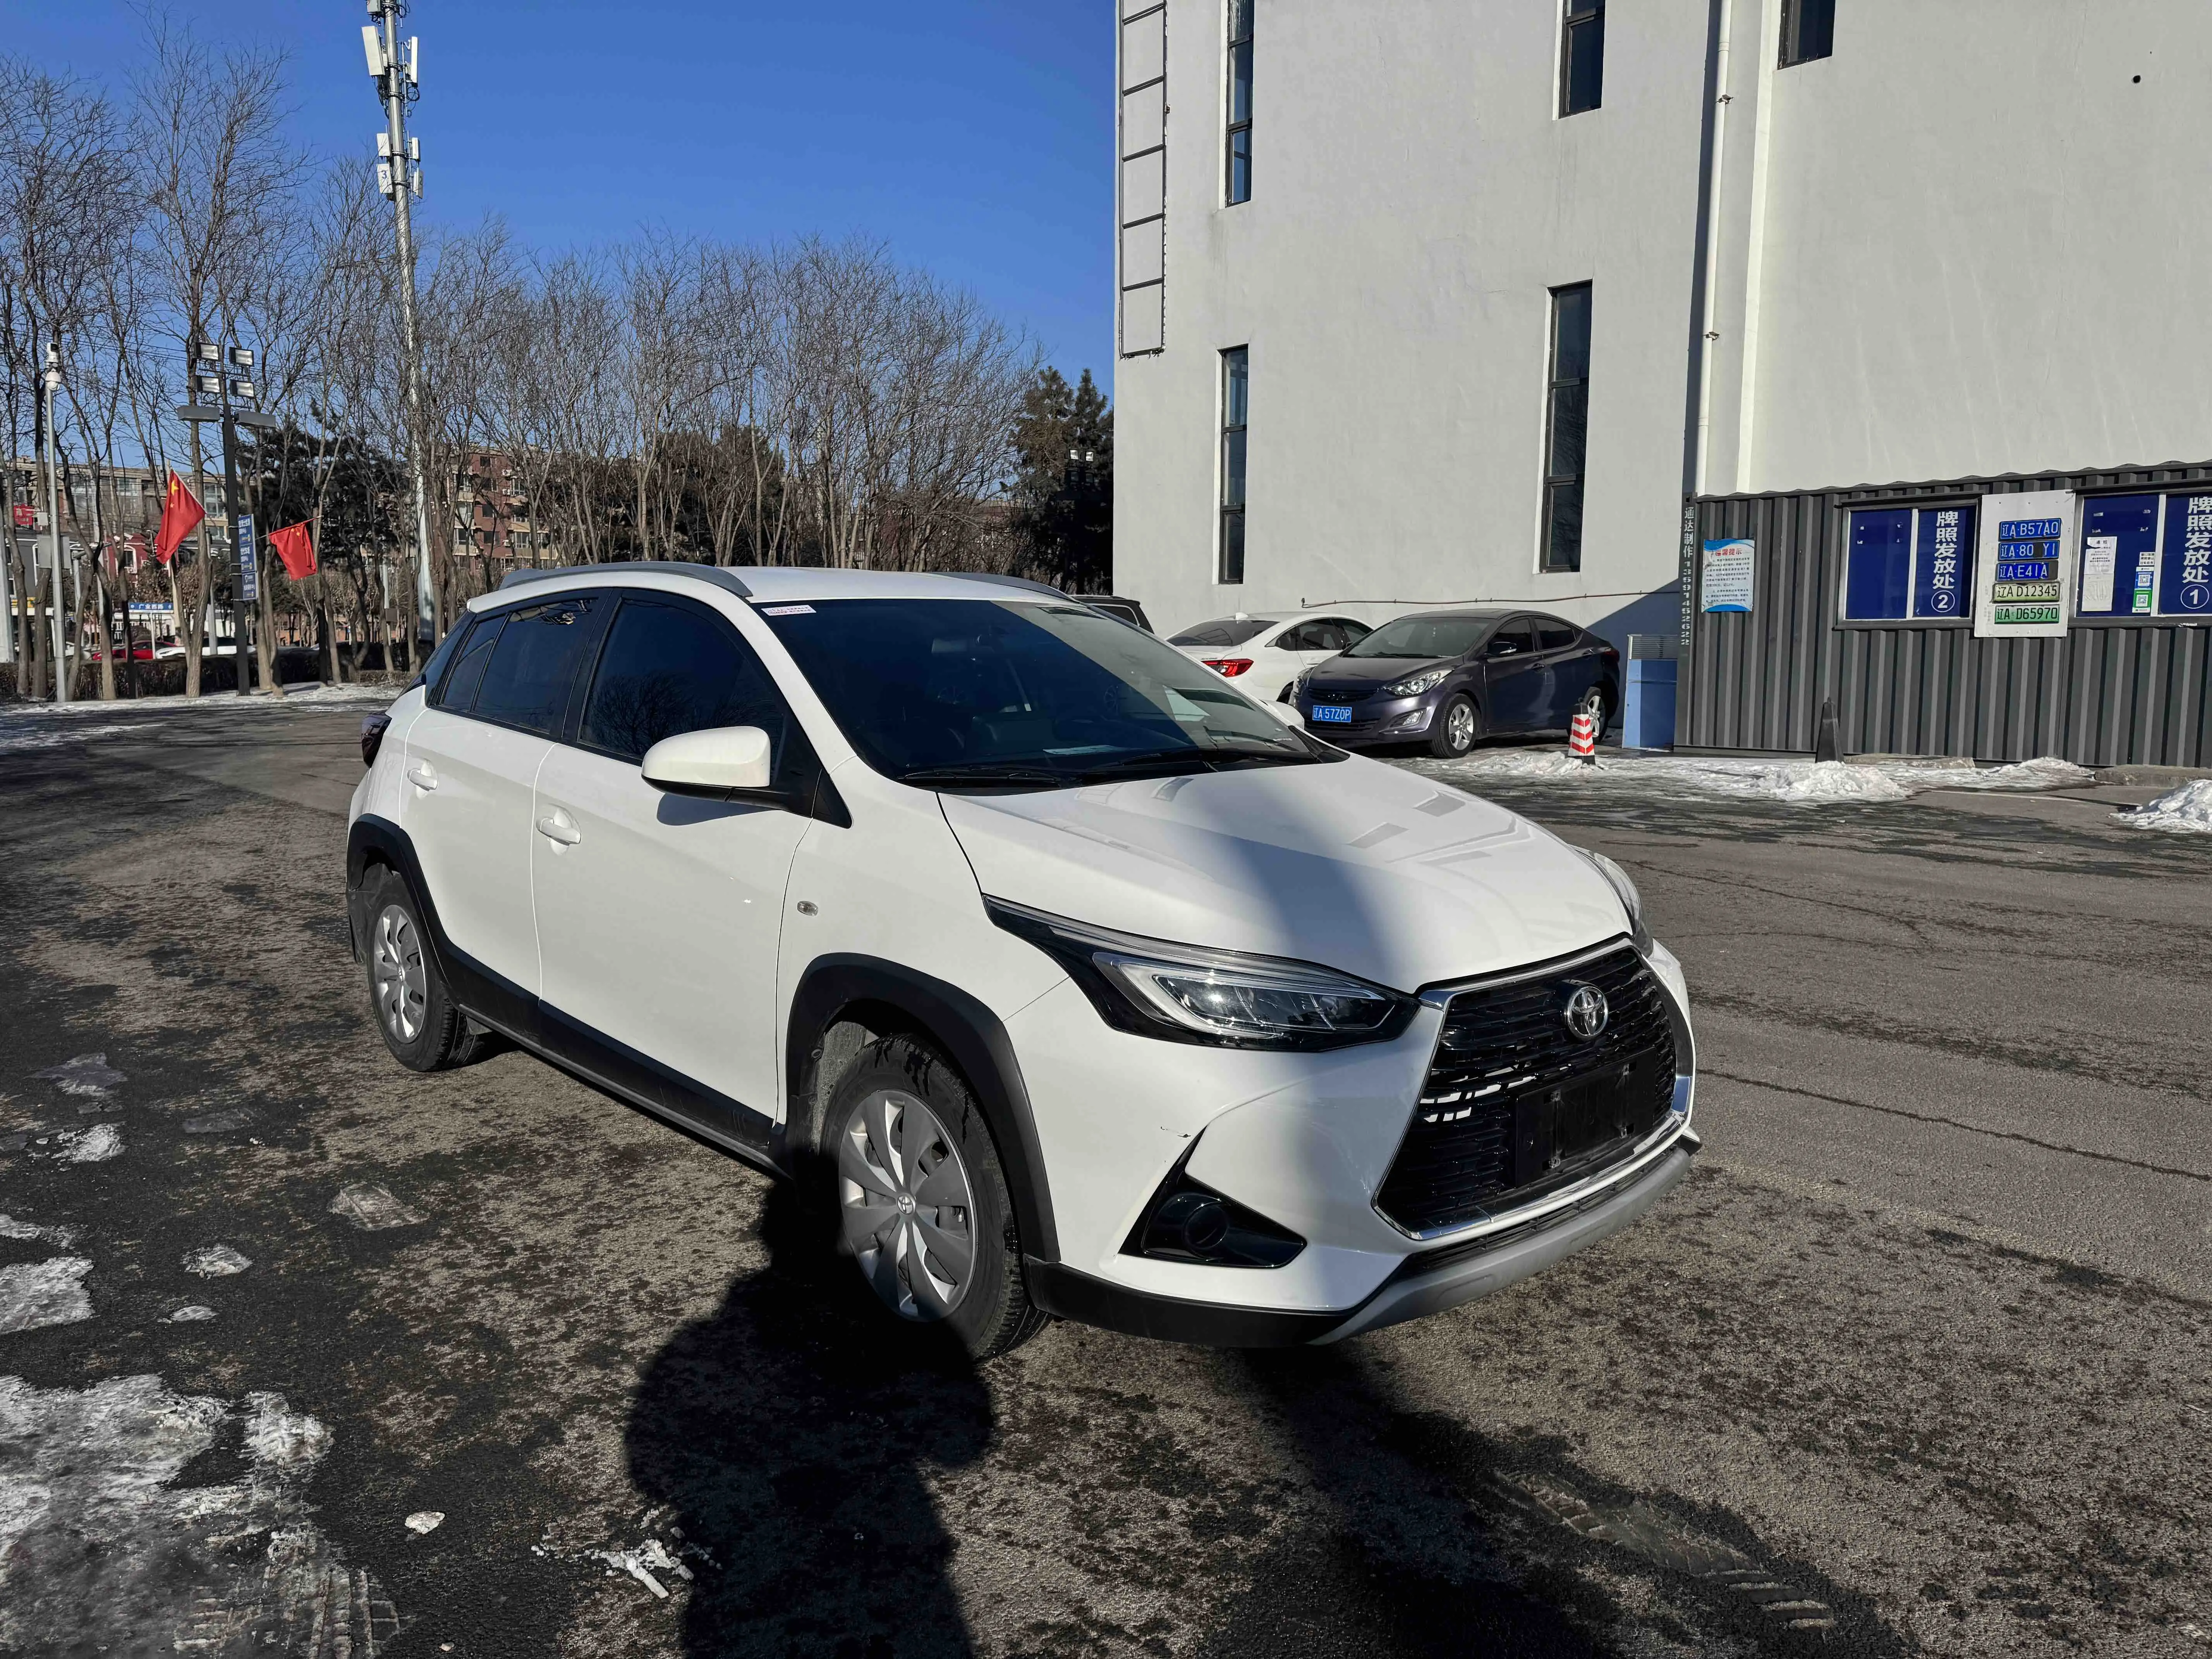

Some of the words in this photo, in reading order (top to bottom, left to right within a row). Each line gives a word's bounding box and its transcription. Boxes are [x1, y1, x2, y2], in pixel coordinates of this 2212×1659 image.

[1683, 507, 1694, 558] 通达制作
[1933, 511, 1958, 589] 牌照发放处
[2182, 496, 2212, 583] 牌照发放处
[1681, 561, 1692, 645] 13591452622
